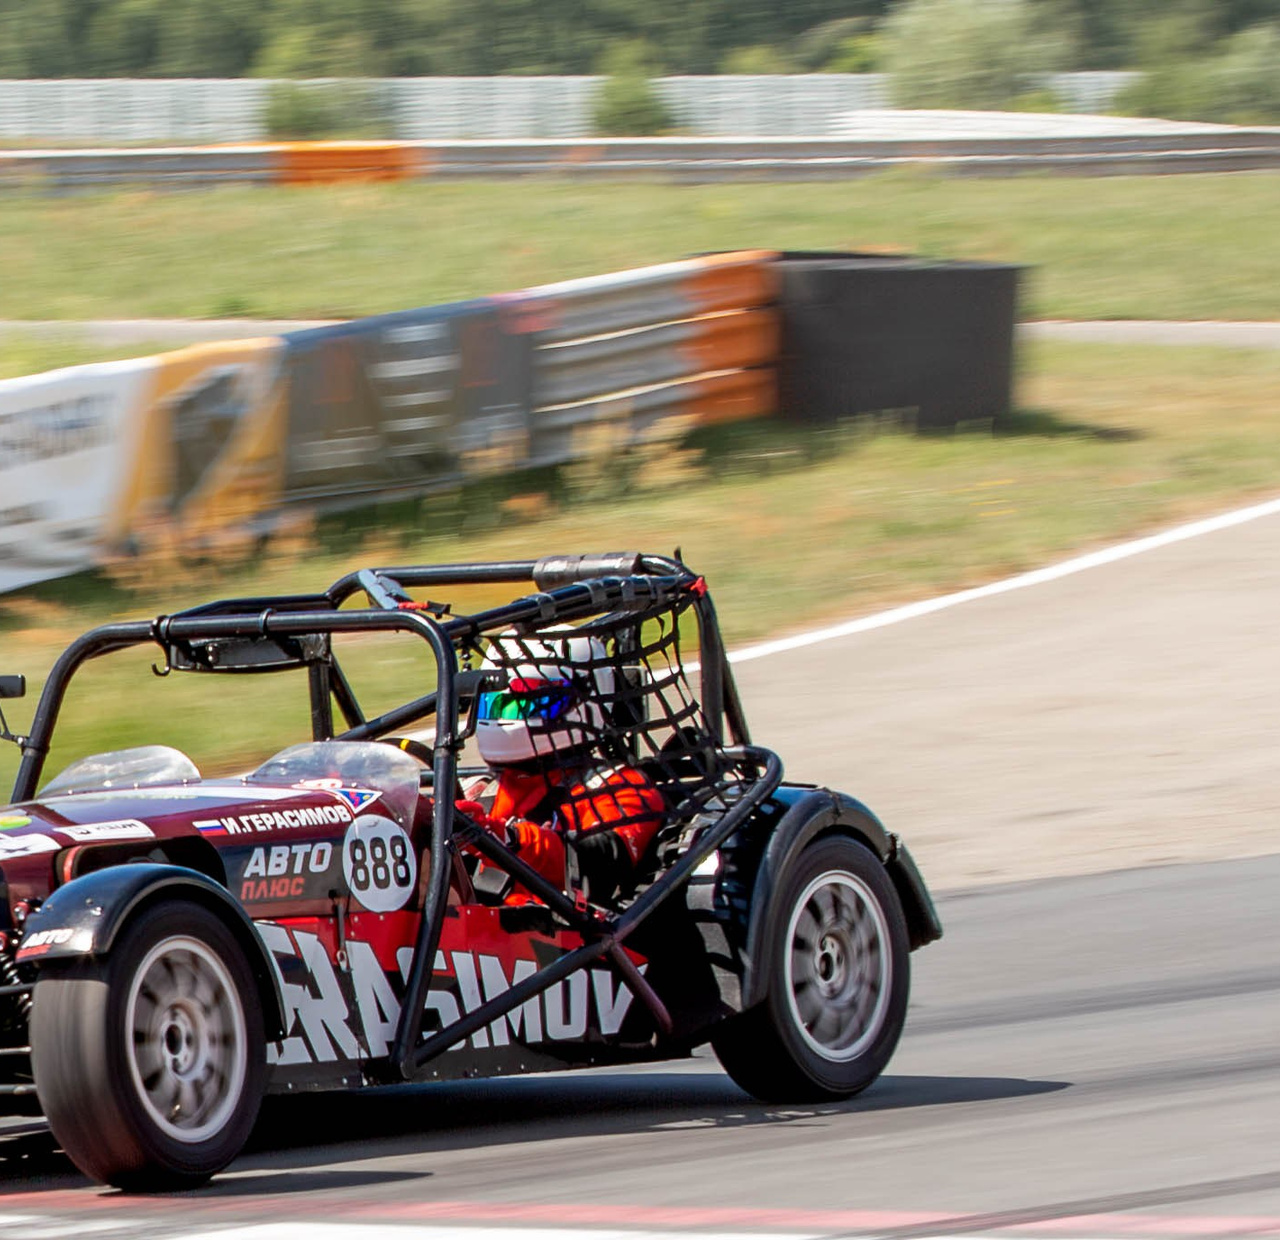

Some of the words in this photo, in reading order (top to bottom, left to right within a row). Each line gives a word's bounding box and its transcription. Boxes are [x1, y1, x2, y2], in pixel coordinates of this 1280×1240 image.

[220, 805, 352, 835] И.ГЕРАСИМОВ
[243, 842, 332, 878] АВТО
[350, 835, 412, 891] 888
[240, 877, 305, 900] ПЛЮС
[253, 921, 649, 1065] ERASIMOV
